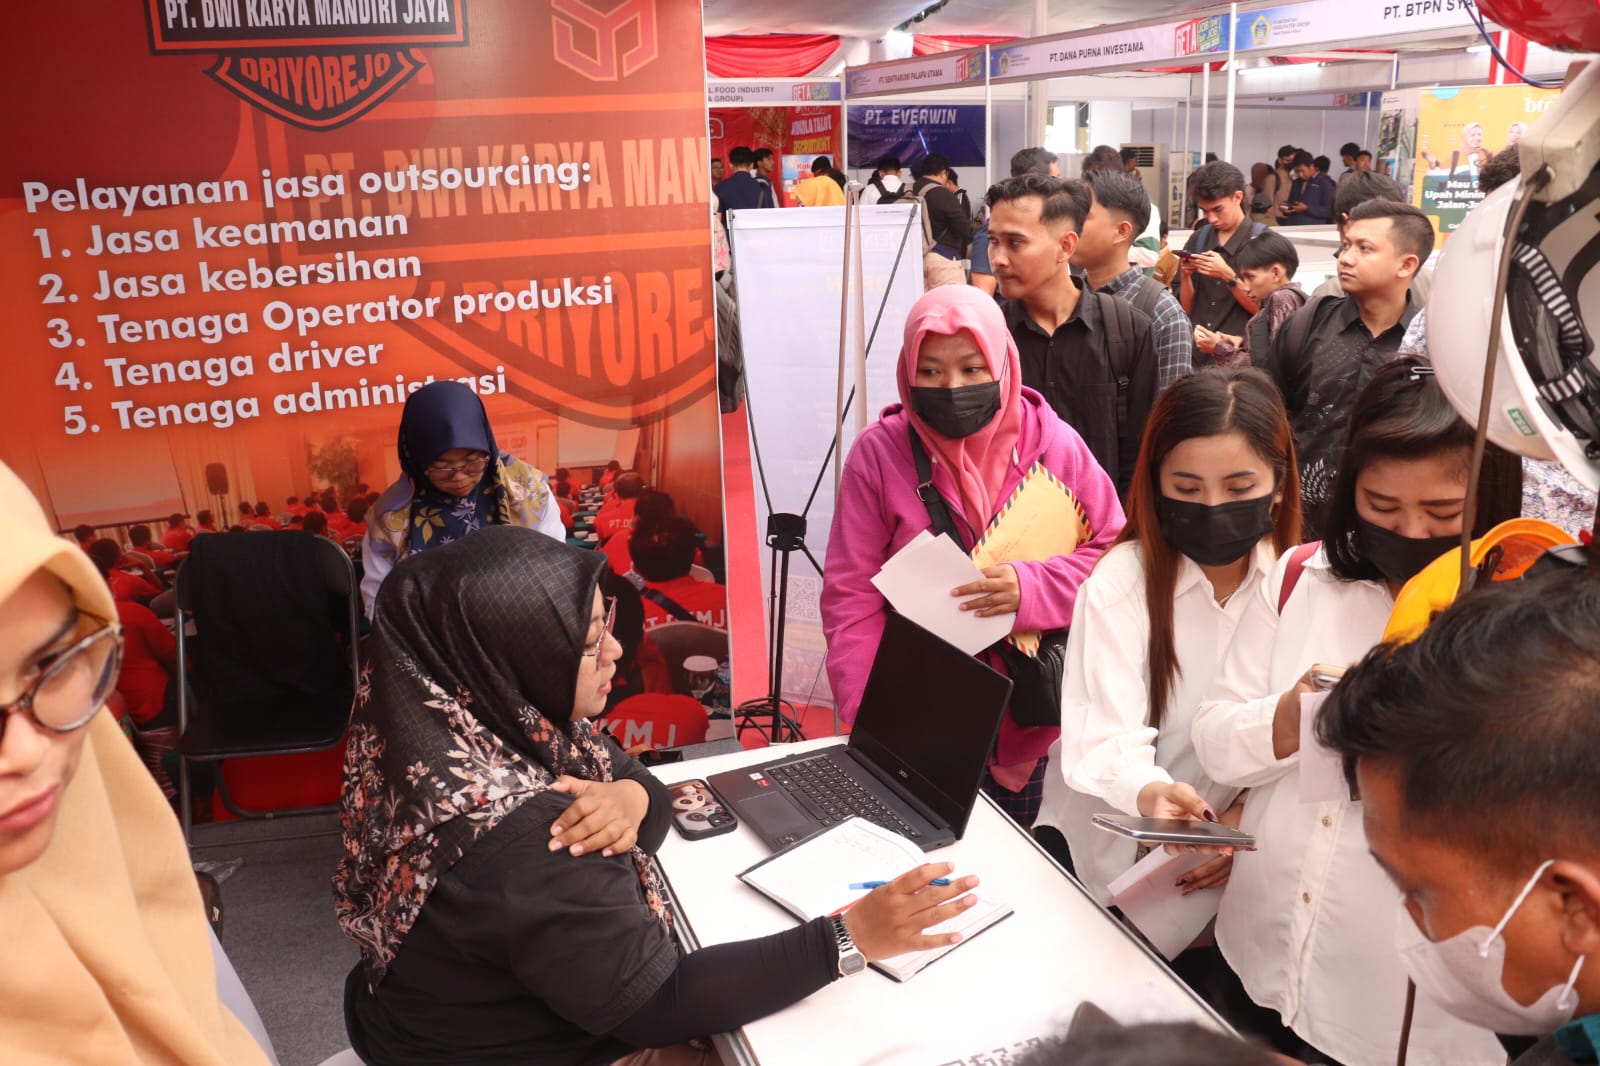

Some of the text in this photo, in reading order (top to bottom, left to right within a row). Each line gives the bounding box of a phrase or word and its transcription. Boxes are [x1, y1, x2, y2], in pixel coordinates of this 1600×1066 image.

[165, 0, 450, 29] PT. DWI KARYA MANDIRI JAYA
[1383, 0, 1477, 20] PT. BTPN SYA
[1049, 41, 1145, 62] PT. DANA PURNA INVESTAMA
[239, 52, 392, 111] DRIYOREJO
[715, 86, 736, 94] FOOD
[738, 86, 775, 94] INDUSTRY
[863, 108, 957, 126] PT. EVERWIN
[23, 154, 593, 217] Pelayanan jasa outsourcing:
[1424, 190, 1453, 200] Upah
[1447, 180, 1471, 189] Mau
[34, 211, 409, 259] 1. Jasa keamanan
[38, 250, 422, 305] 2. Jasa kebersihan
[47, 275, 614, 349] 3. Tenaga Operator produksi
[463, 266, 715, 388] DRIYORE
[54, 339, 385, 392] 4. Tenaga driver
[63, 405, 101, 436] 5.
[111, 395, 261, 433] Tenaga
